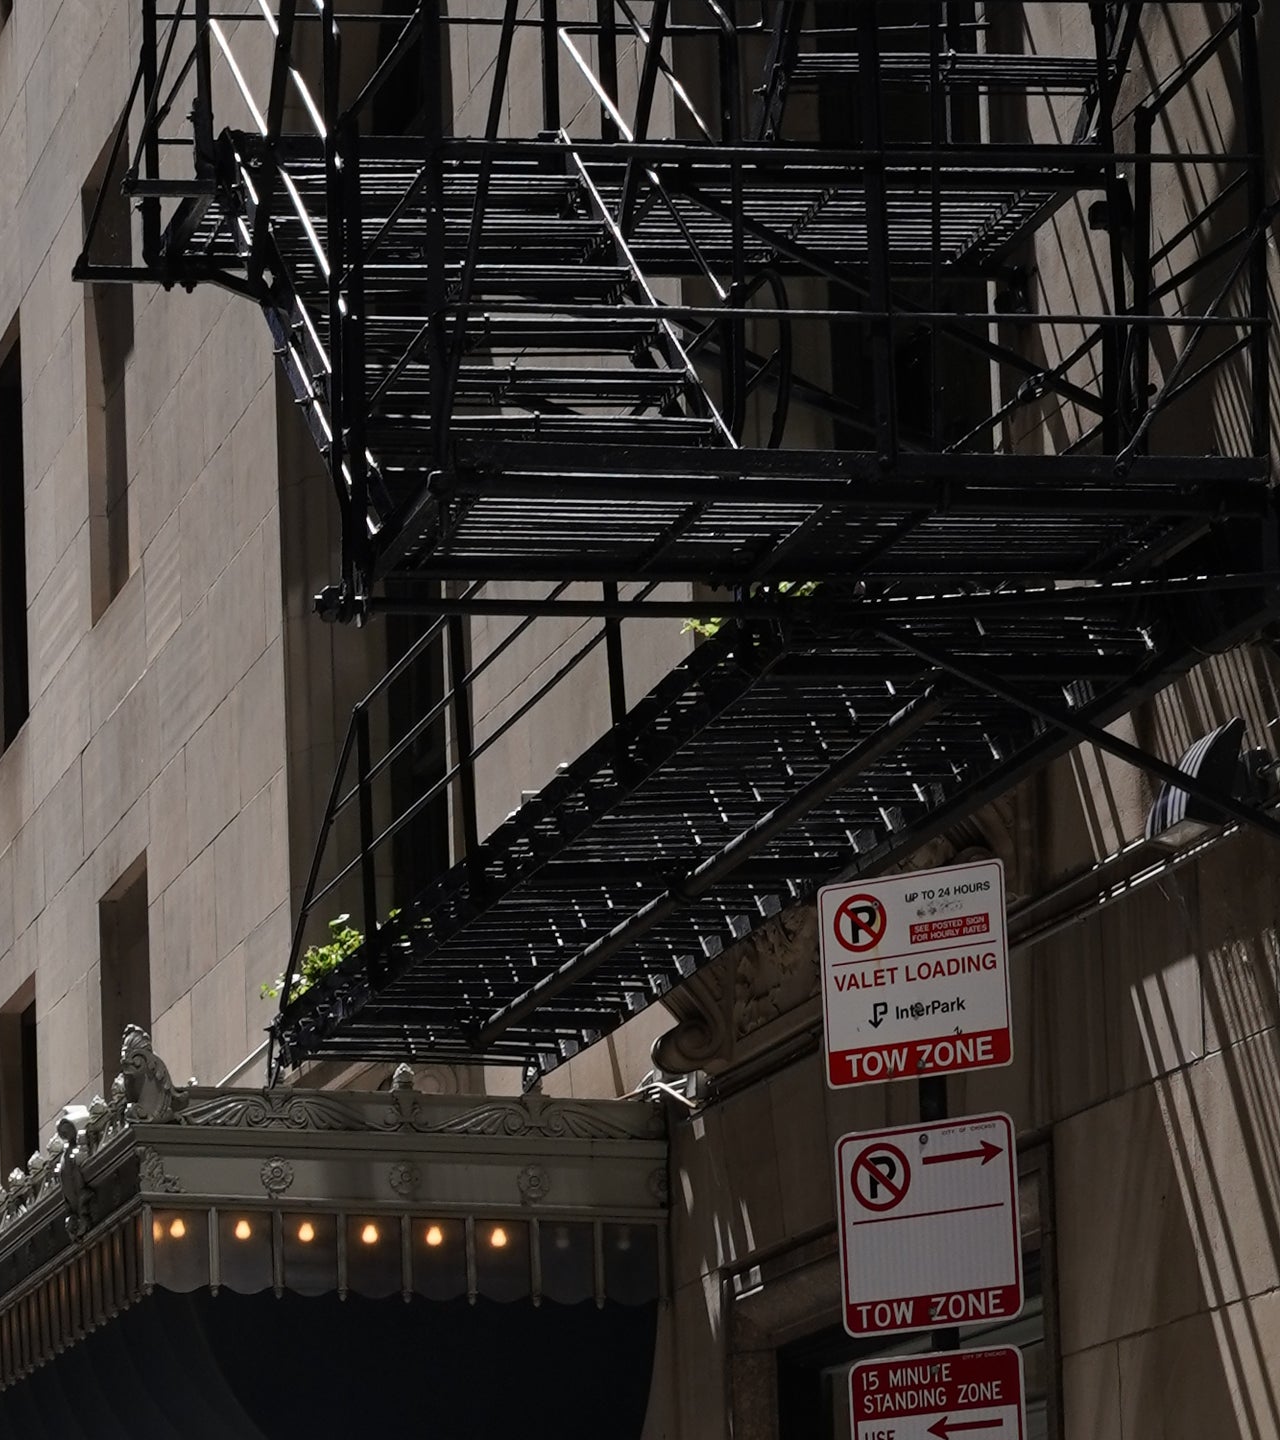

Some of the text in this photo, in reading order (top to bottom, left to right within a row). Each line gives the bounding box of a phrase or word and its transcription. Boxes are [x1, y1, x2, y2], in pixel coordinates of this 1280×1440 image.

[905, 881, 990, 902] UP TO 24 HOURS
[912, 924, 987, 942] FOR HOURLY RATES
[914, 924, 930, 933] SEE
[932, 920, 963, 931] POSTED
[834, 953, 996, 992] VALET LOADING
[896, 997, 966, 1020] InterPark
[845, 1035, 994, 1078] TOW ZONE
[857, 1290, 1005, 1329] TOW ZONE
[862, 1363, 952, 1391] 15 MINUTE
[864, 1380, 1003, 1413] STANDING ZONE
